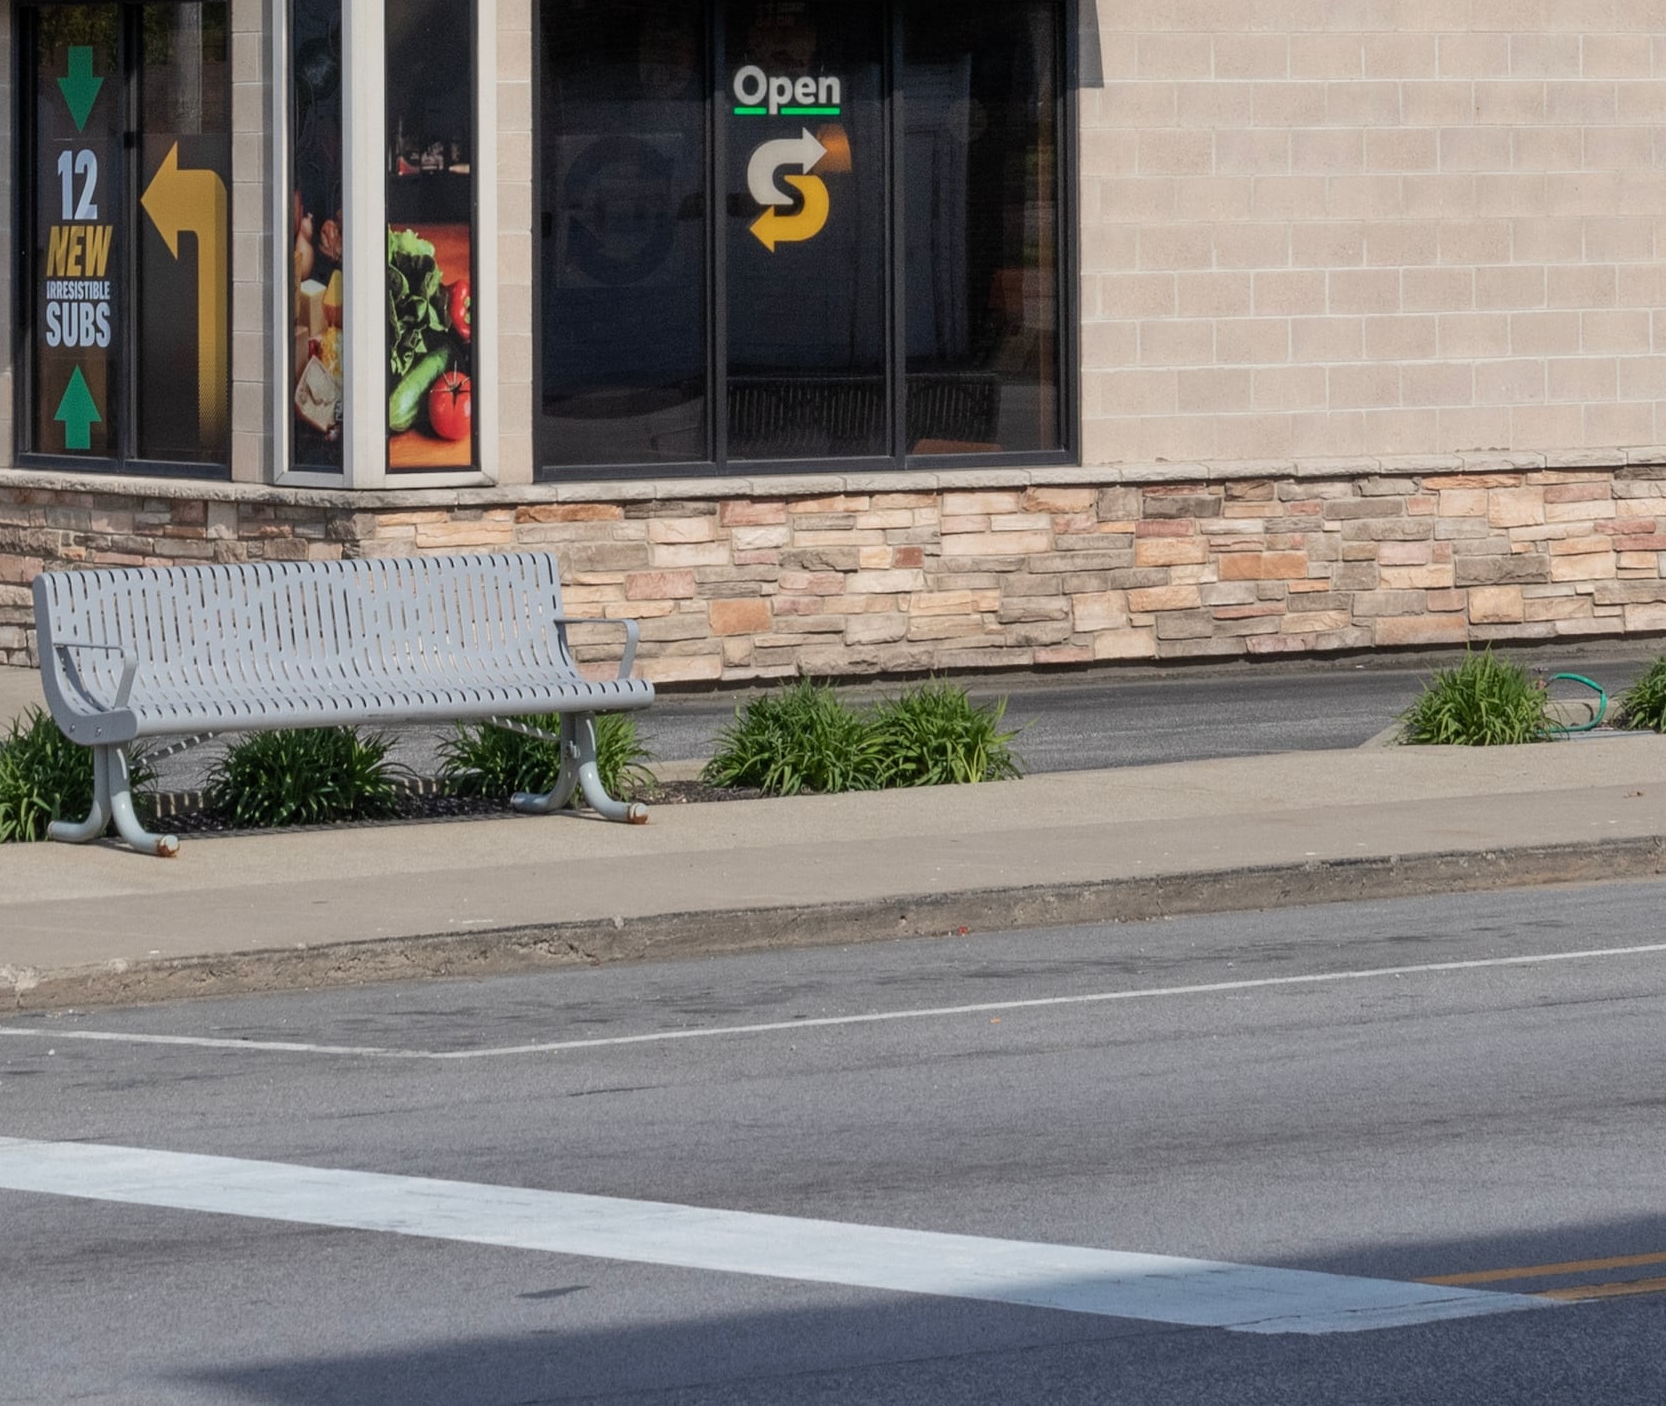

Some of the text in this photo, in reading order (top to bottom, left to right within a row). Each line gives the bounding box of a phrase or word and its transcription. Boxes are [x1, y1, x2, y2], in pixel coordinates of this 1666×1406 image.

[733, 65, 841, 115] Open
[58, 149, 98, 220] 12
[47, 225, 113, 277] NEW
[46, 281, 111, 300] IRRESISTIBLE
[46, 301, 111, 348] SUBS
